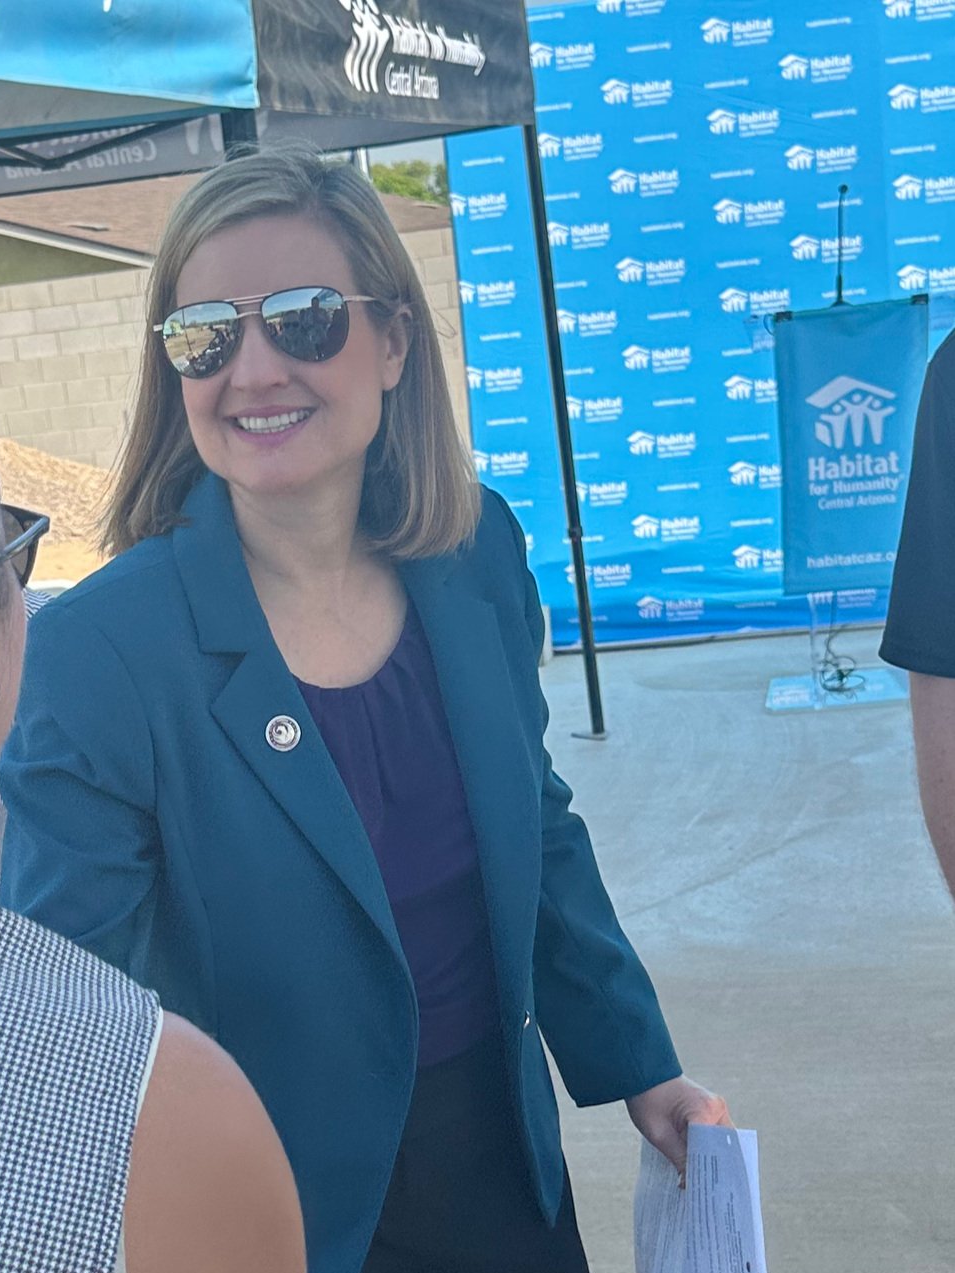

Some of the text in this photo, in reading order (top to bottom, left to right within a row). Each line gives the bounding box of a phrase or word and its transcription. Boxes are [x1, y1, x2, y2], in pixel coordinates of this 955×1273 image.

[808, 452, 899, 480] Habitat
[809, 476, 899, 496] for Humanity
[818, 494, 896, 510] Central Arizona
[807, 551, 895, 568] habitatcaz.o
